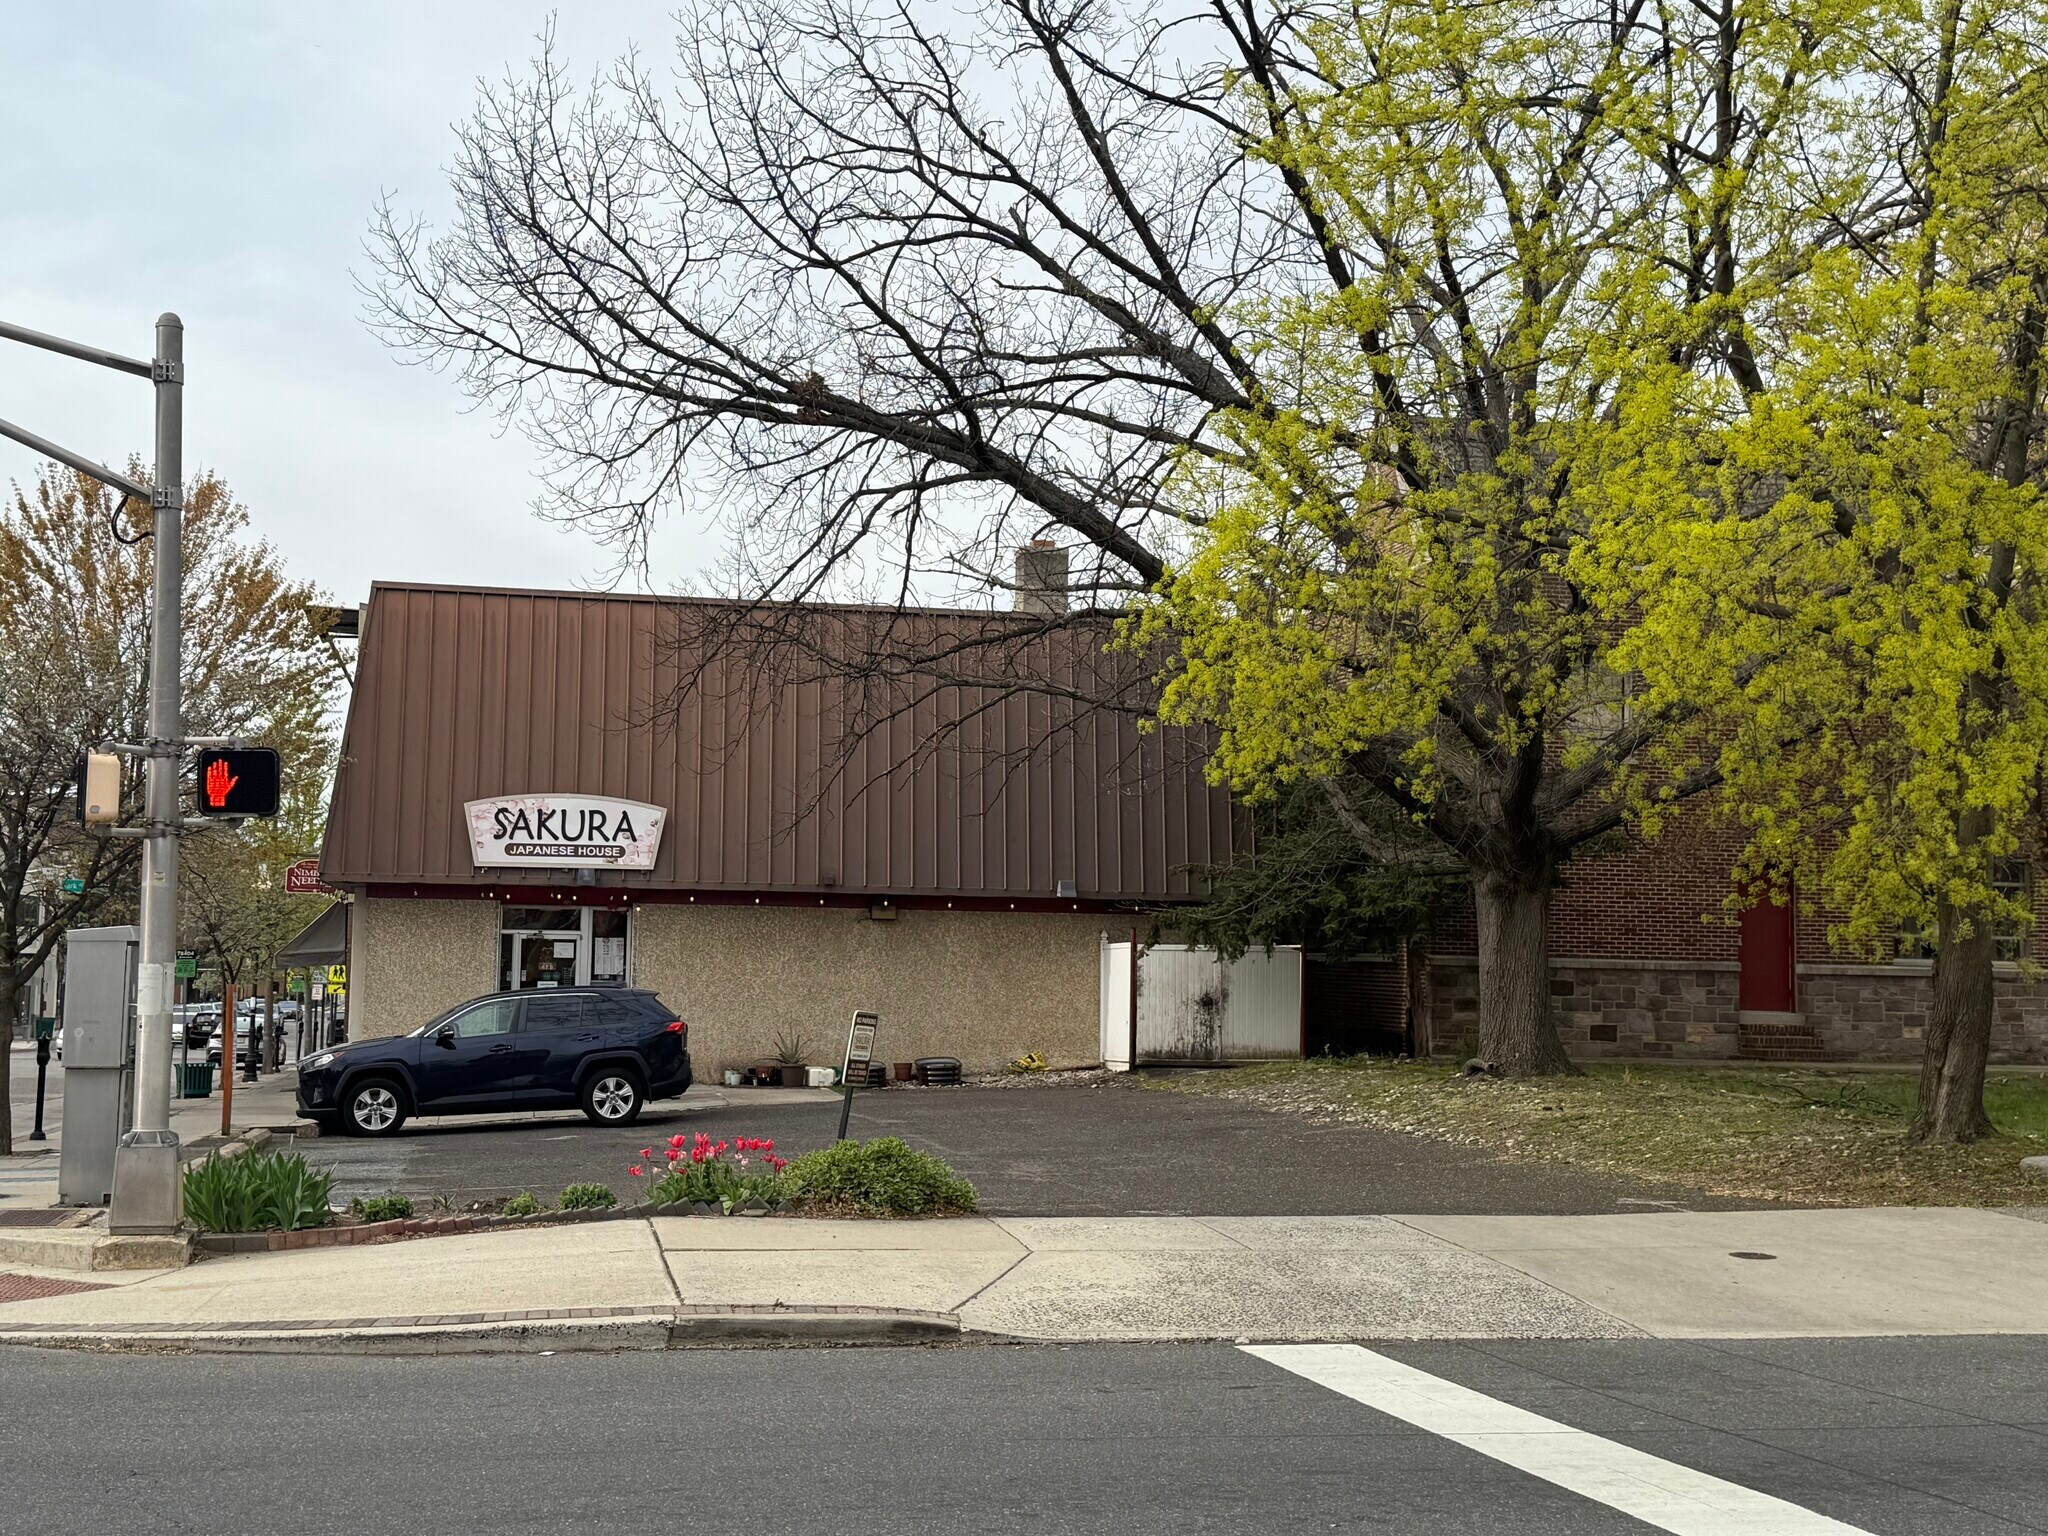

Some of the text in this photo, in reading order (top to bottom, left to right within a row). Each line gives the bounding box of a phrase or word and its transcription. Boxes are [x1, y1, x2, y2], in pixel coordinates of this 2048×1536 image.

[494, 807, 637, 842] SAKURA
[509, 845, 621, 857] JAPANESE HOUSE
[293, 868, 320, 877] NIMB
